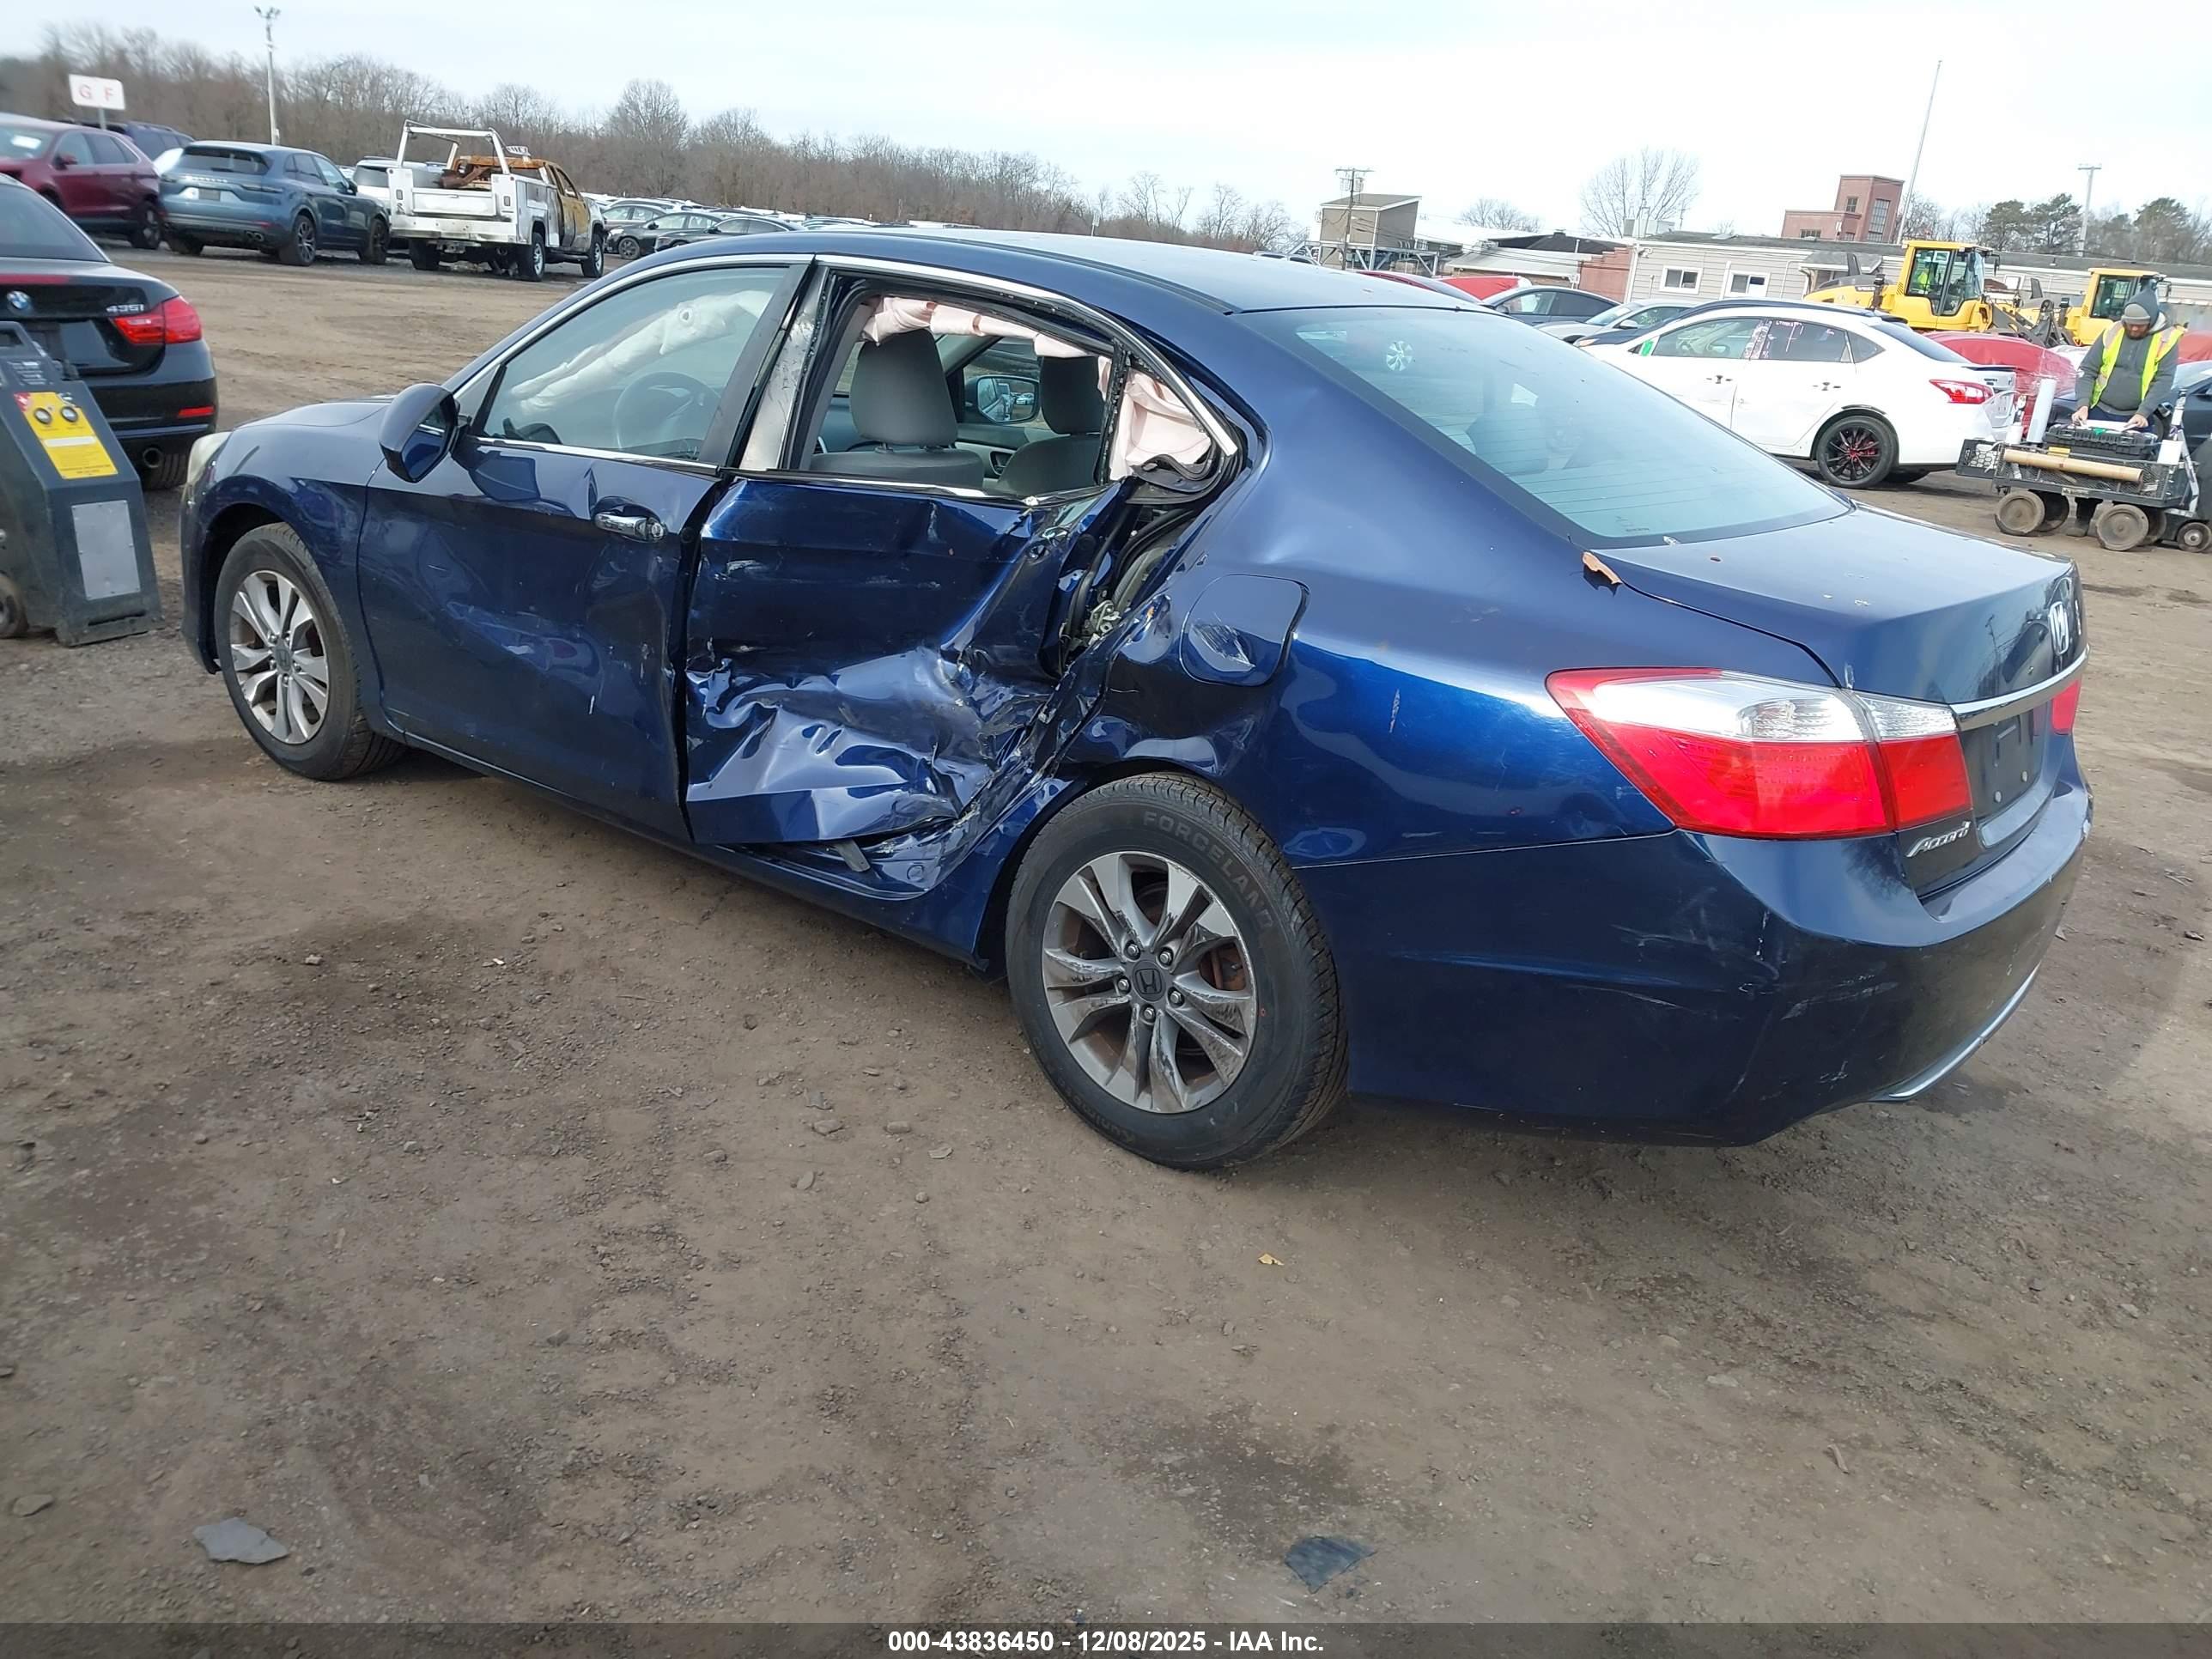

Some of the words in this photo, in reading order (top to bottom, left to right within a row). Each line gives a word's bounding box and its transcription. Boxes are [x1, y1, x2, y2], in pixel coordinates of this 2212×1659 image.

[104, 87, 114, 101] F
[1906, 820, 1972, 858] Accord
[1142, 811, 1274, 928] FORCELAND
